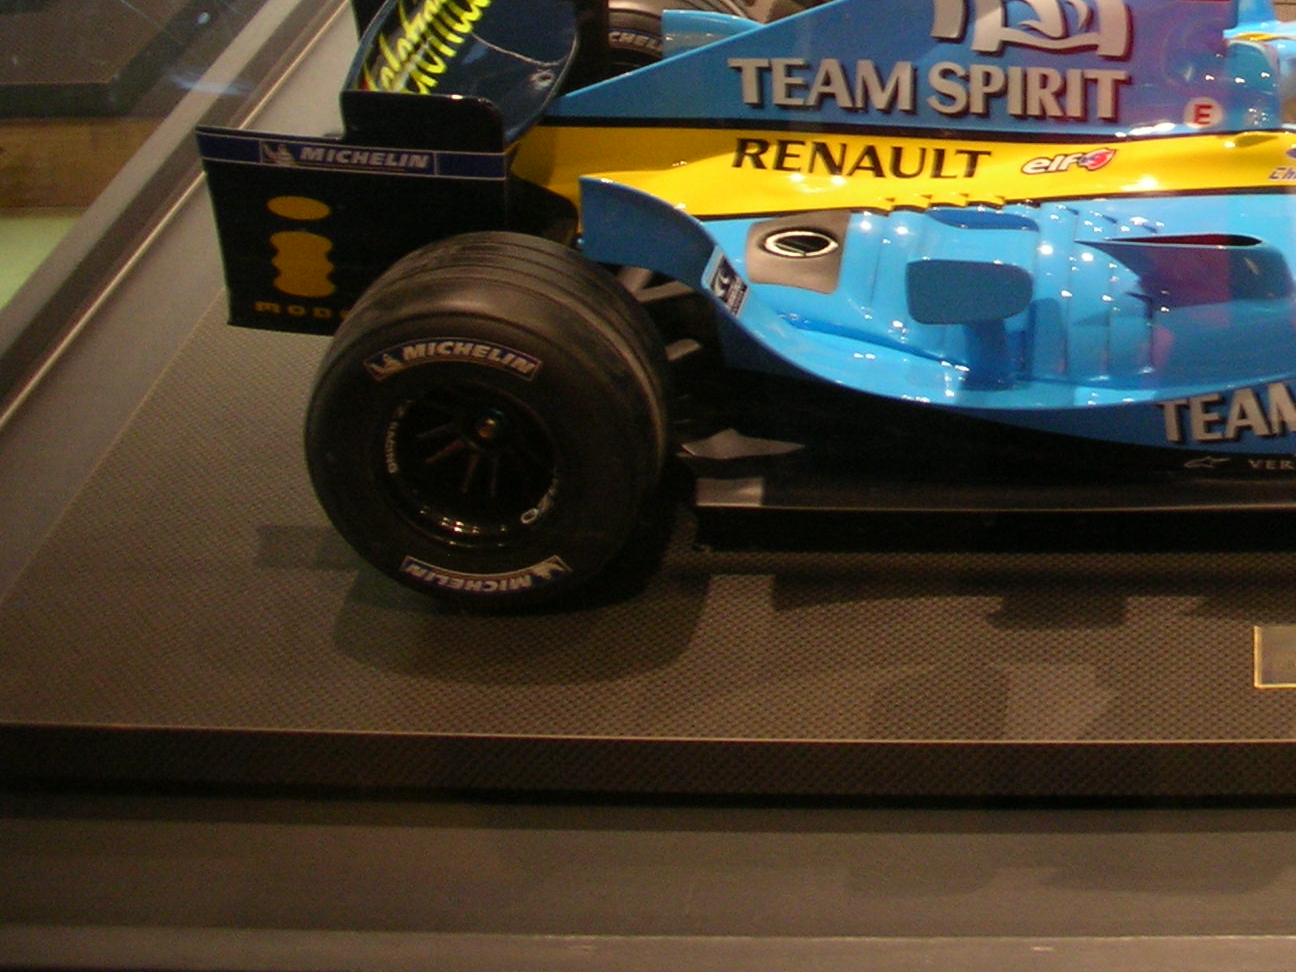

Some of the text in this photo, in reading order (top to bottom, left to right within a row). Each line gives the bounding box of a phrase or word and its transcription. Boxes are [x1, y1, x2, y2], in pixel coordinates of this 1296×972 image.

[728, 57, 1132, 124] TEAM SPIRIT
[1193, 103, 1213, 126] E
[300, 147, 430, 169] MICHELIN
[733, 137, 992, 179] RENAULT
[1022, 152, 1082, 174] elf
[403, 340, 535, 377] MICHELIN
[406, 561, 533, 593] MICHELIN
